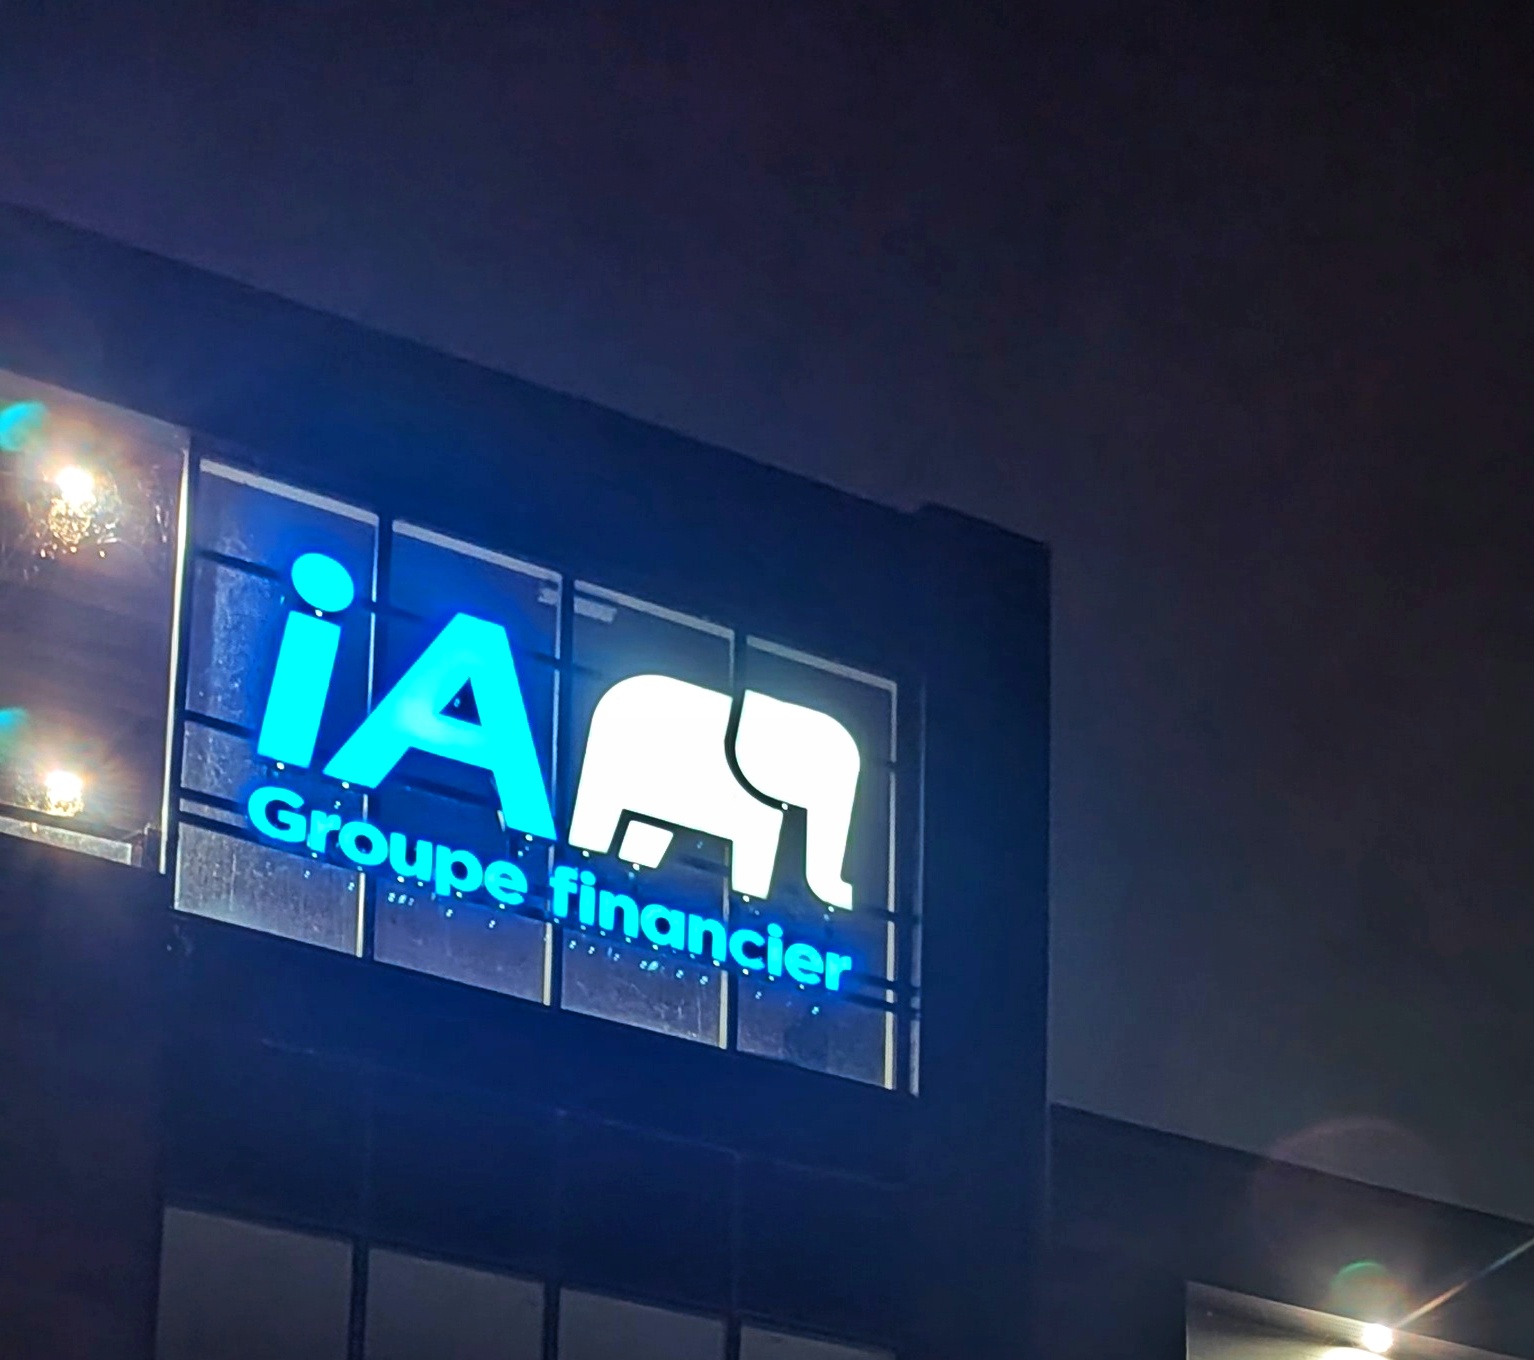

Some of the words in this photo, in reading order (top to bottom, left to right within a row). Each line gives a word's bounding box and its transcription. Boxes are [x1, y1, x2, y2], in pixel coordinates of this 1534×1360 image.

[257, 552, 557, 841] iA
[247, 785, 528, 905] Groupe
[550, 864, 852, 992] financier
